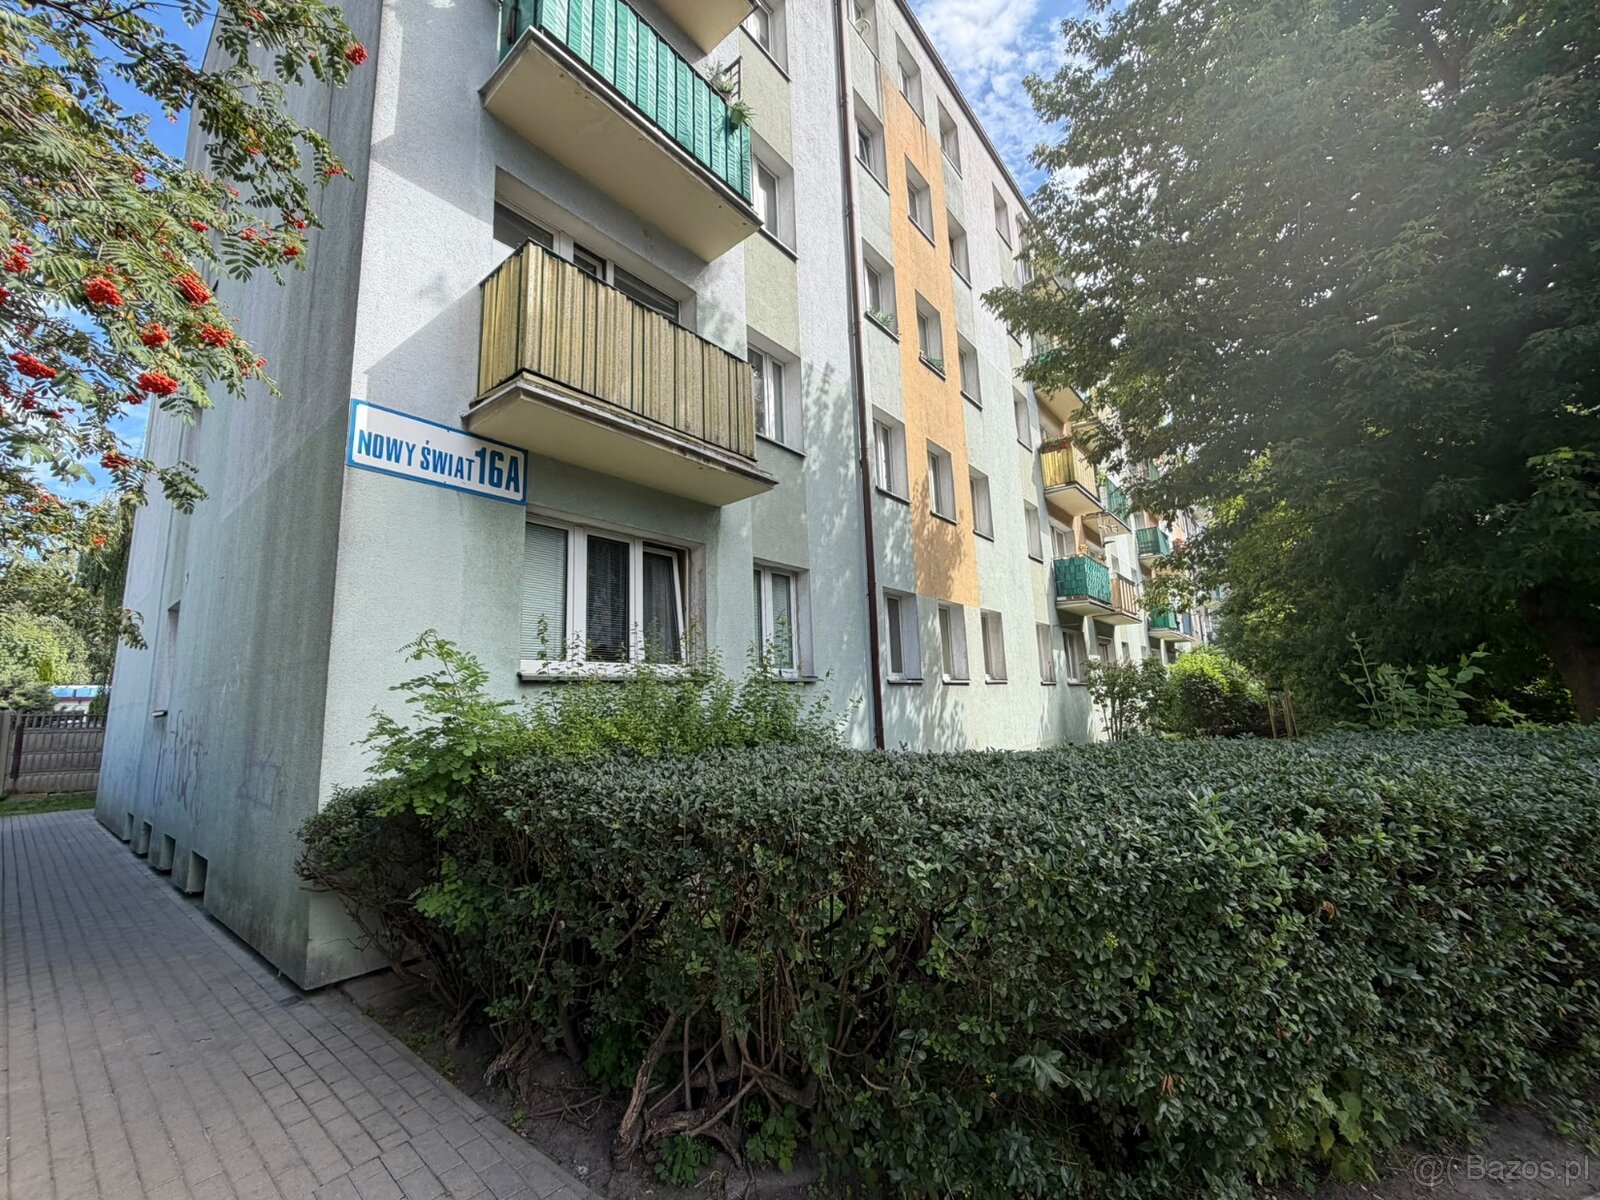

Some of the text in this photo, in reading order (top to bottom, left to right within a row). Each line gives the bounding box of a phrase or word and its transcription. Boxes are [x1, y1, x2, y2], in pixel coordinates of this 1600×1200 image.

[357, 429, 520, 494] NOWY ŚWIAT 16A
